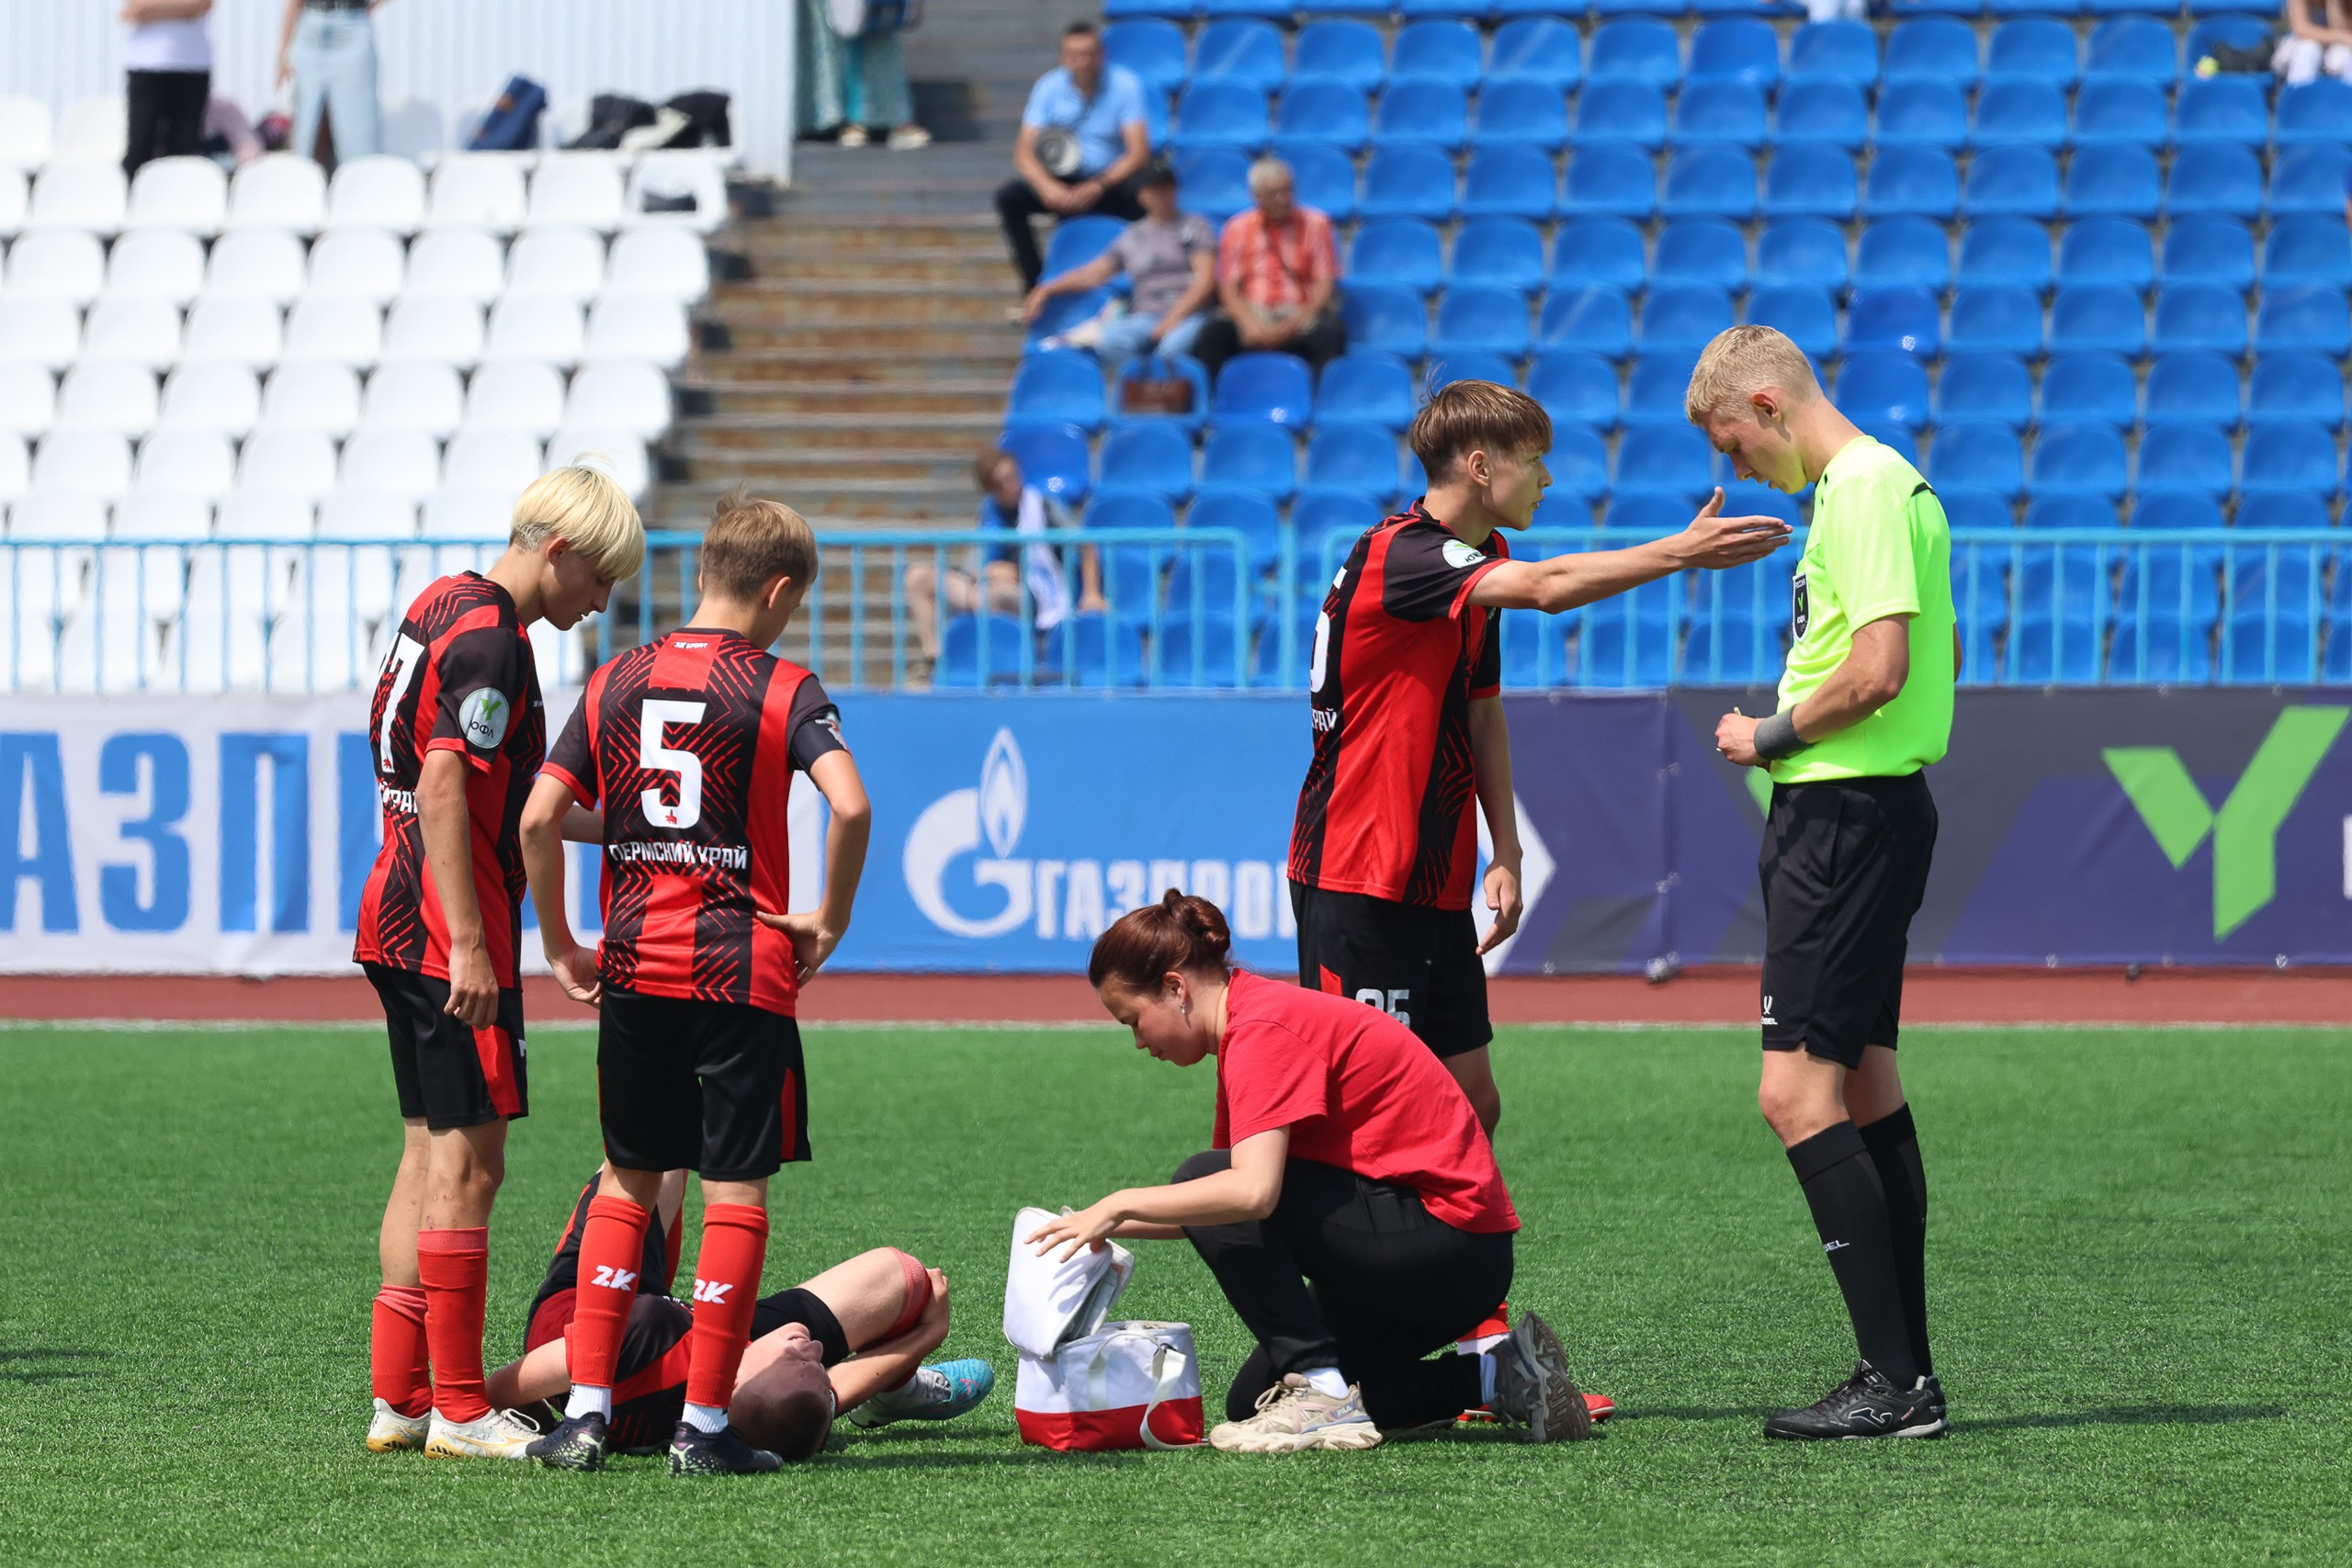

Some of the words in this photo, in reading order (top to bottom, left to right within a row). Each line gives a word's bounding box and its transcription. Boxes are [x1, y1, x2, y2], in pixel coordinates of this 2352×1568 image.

[639, 699, 707, 829] 5
[0, 732, 377, 931] АЗП
[608, 840, 695, 864] ПЕРМСКИЙ
[696, 845, 748, 870] КРАЙ
[1035, 859, 1296, 940] ГАЗПРО
[591, 1265, 637, 1291] 2K
[693, 1279, 733, 1304] 2K
[1337, 1405, 1352, 1416] FILA
